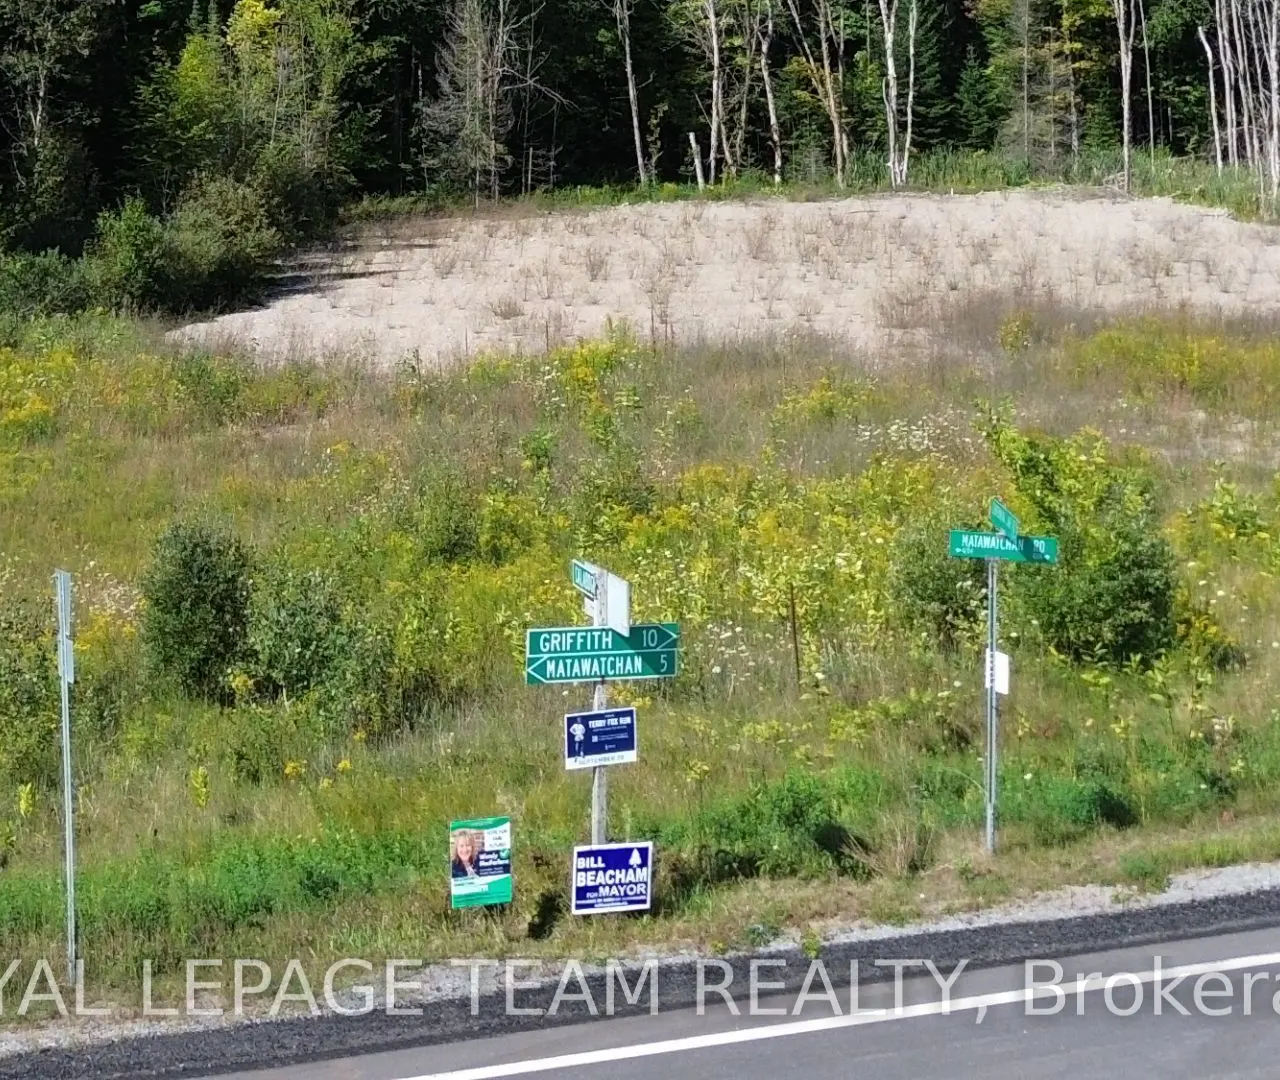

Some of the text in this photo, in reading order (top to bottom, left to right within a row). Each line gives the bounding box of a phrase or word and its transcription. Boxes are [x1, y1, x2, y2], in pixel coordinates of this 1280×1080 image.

[961, 534, 1046, 553] MATAWATCHAN RD
[539, 629, 658, 652] GRIFFITH 10
[546, 654, 668, 679] MATAWATCHAN 5
[607, 718, 619, 726] FOX
[577, 856, 606, 869] BILL
[576, 867, 648, 887] BEACHAM
[598, 883, 647, 897] MAYOR
